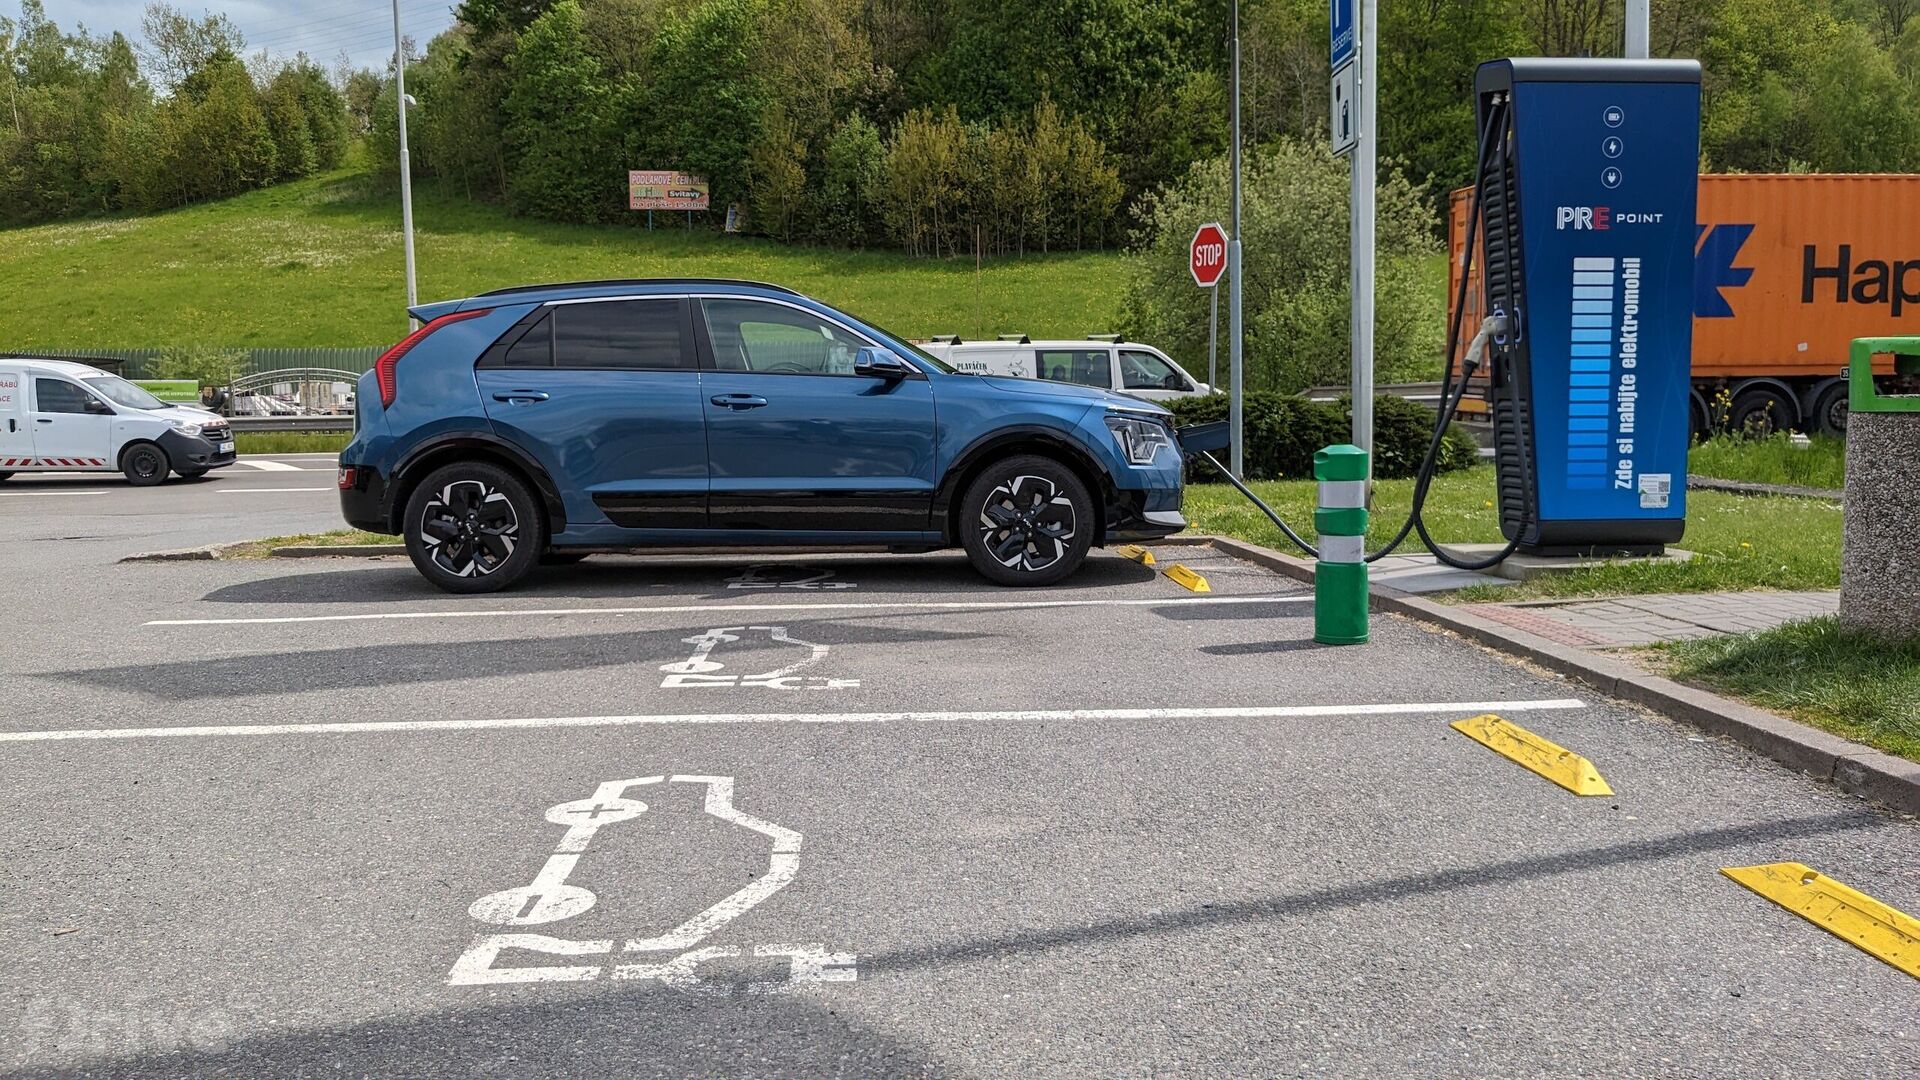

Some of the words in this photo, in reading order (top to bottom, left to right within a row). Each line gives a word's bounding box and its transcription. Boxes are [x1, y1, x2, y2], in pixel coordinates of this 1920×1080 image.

[669, 190, 700, 198] Svitavy
[1556, 206, 1610, 230] PRE
[1616, 213, 1664, 223] POINT
[1195, 243, 1222, 267] STOP
[1801, 244, 1920, 317] Hap
[1619, 257, 1641, 369] elektromobil
[1617, 374, 1638, 433] nabijte
[1616, 438, 1634, 454] si
[1615, 459, 1633, 490] Zde
